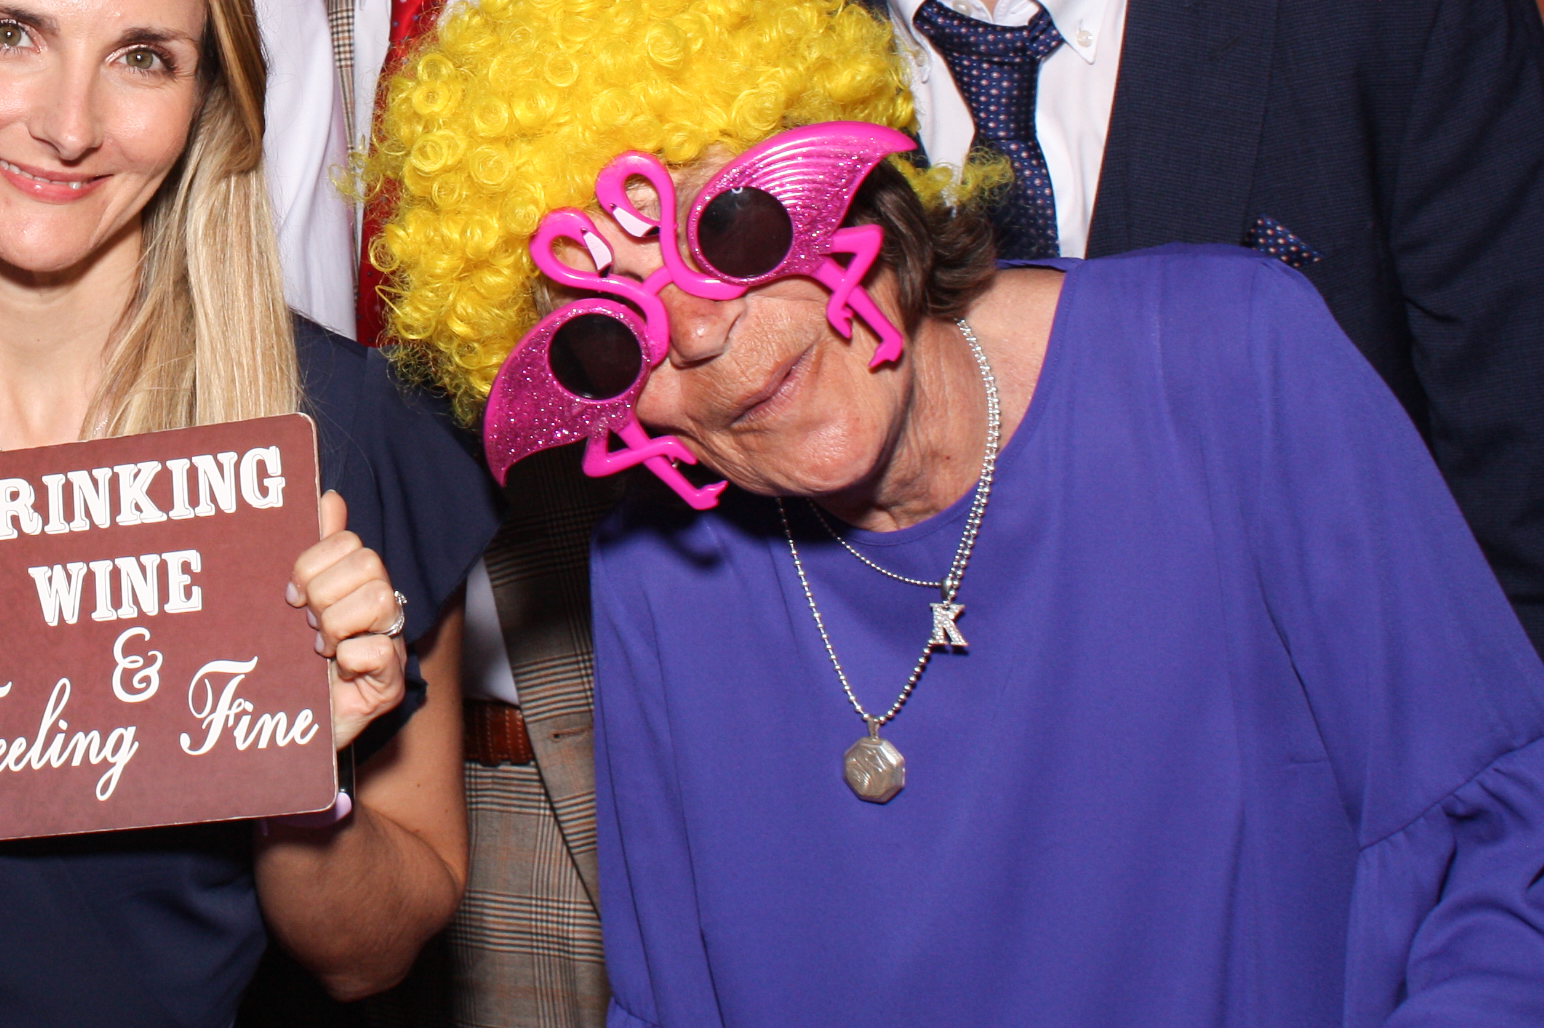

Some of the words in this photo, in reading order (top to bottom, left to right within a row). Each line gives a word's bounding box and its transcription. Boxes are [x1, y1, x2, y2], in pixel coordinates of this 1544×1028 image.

[28, 549, 203, 627] WINE
[929, 602, 969, 647] K
[111, 626, 164, 703] &
[179, 655, 320, 756] Fine
